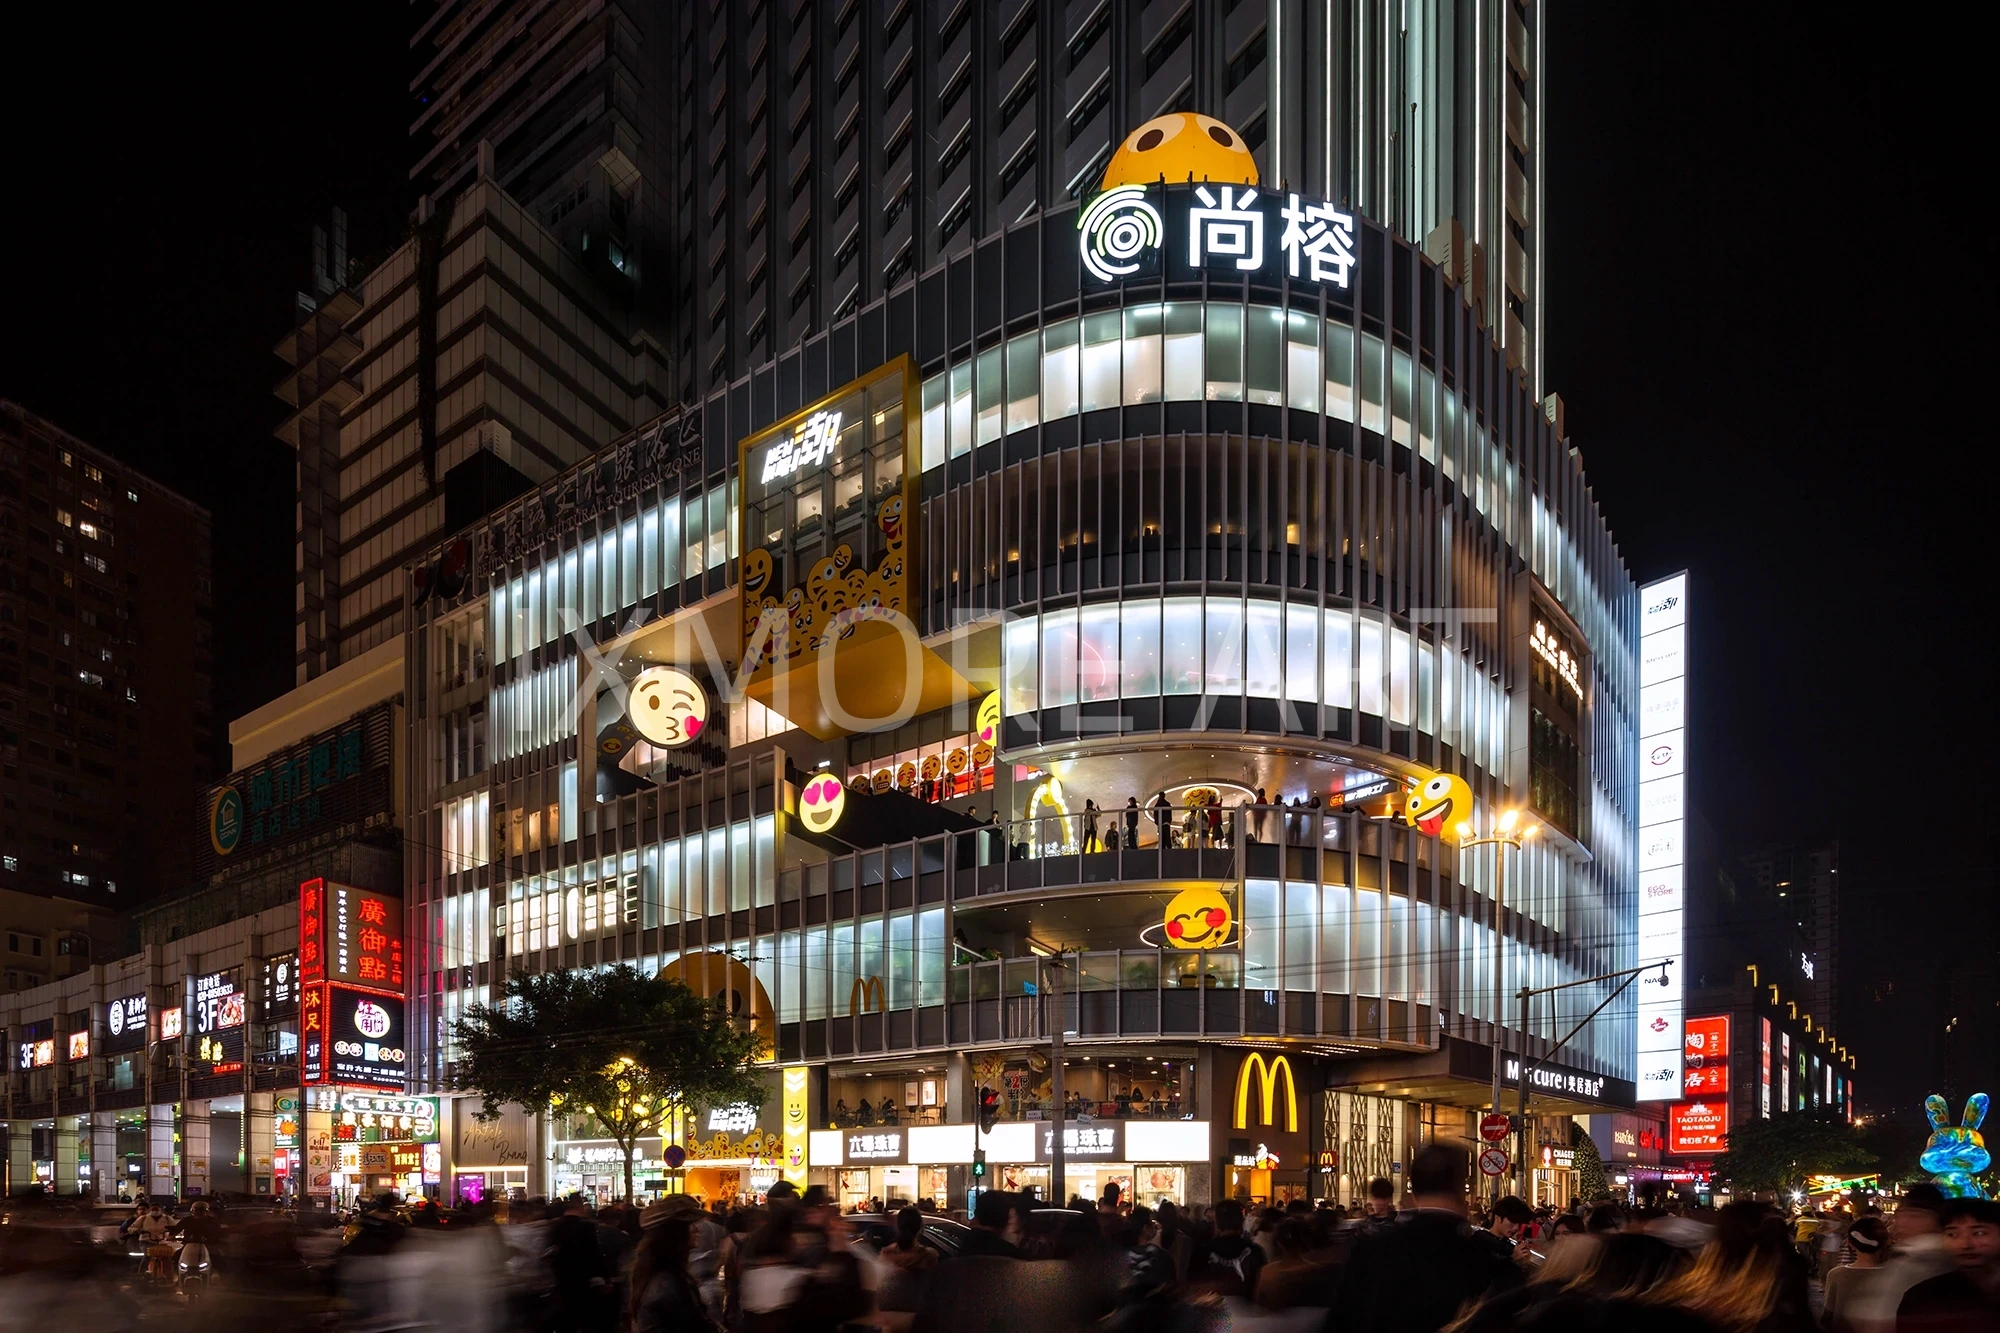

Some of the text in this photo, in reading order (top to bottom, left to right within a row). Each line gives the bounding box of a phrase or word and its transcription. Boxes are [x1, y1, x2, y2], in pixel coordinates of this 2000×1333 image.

[1189, 186, 1357, 289] 尚榕
[514, 533, 546, 557] ROAD
[545, 502, 605, 541] CULTURAL
[605, 471, 663, 512] TOURISM
[663, 447, 700, 478] ZONE
[1647, 884, 1666, 894] EGO
[1647, 888, 1674, 899] STORE
[358, 898, 387, 982] 廣御點
[198, 999, 219, 1033] 3F
[305, 990, 321, 1031] 沐足
[20, 1042, 35, 1069] 3F
[1507, 1060, 1563, 1090] Mcure
[1568, 1074, 1600, 1098] 美居酒店
[1676, 1115, 1722, 1124] TAOTAOJU
